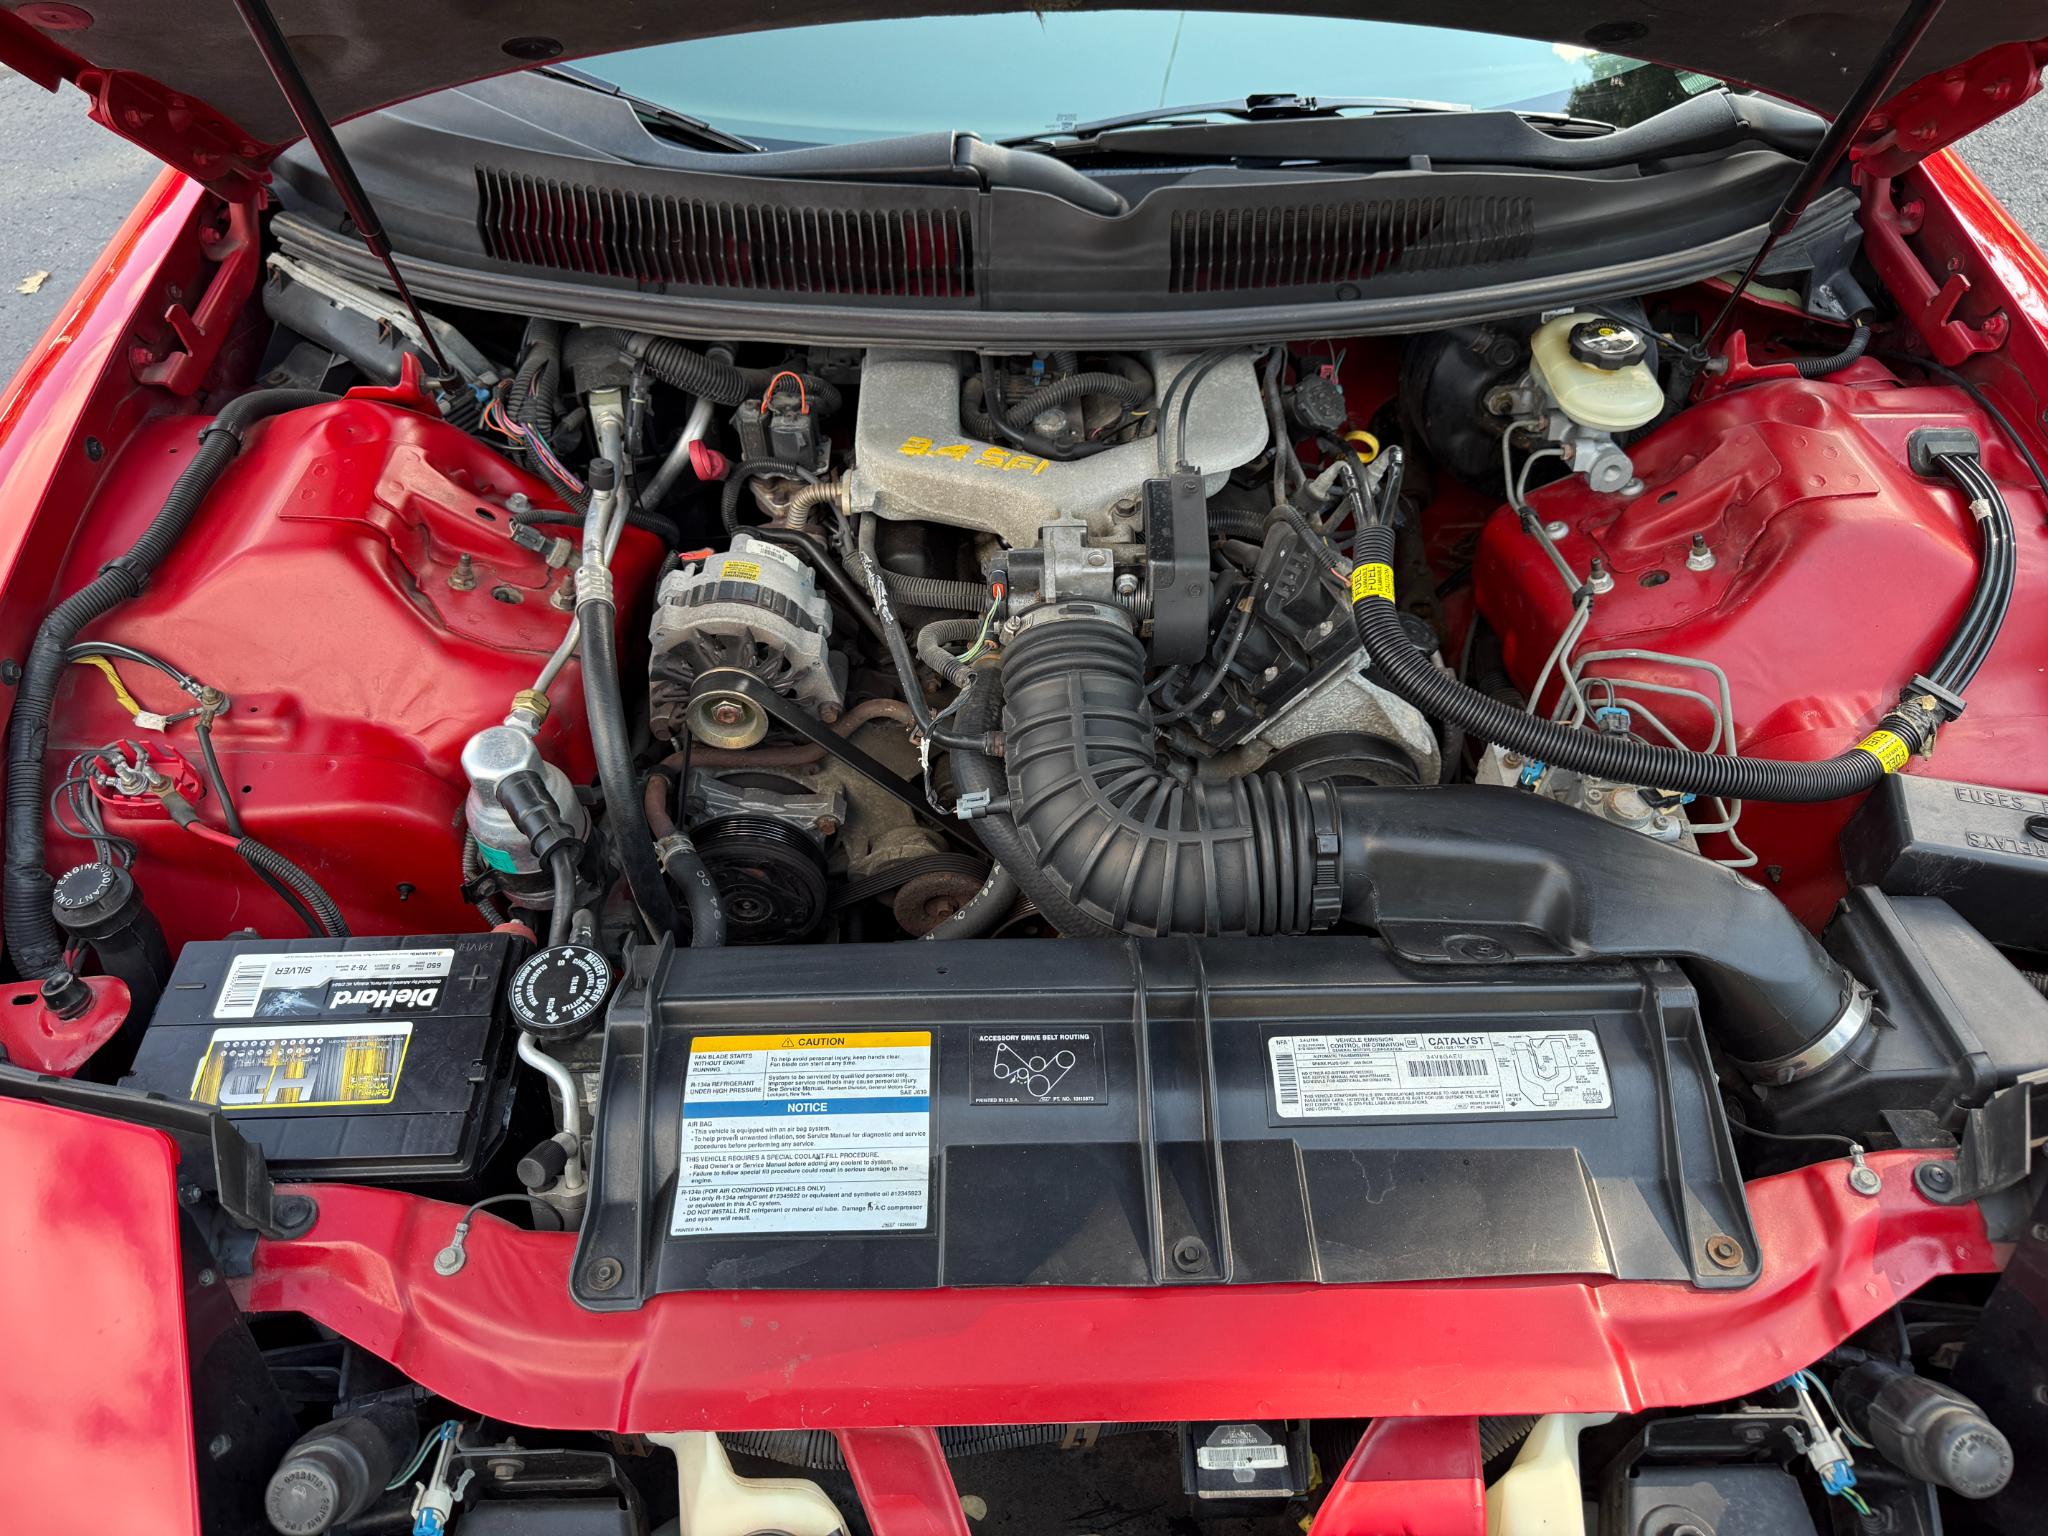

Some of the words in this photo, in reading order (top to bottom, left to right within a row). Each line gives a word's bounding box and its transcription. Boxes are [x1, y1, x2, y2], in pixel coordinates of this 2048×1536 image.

[974, 447, 1050, 475] SFI
[1368, 567, 1376, 590] FUEL
[1864, 734, 1888, 747] FUEL
[1886, 750, 1906, 767] FUEL
[1954, 788, 2025, 810] FUSES
[1966, 832, 2047, 855] RELAYS
[57, 862, 101, 885] ENGINE
[78, 867, 111, 905] COOLANT
[54, 889, 73, 906] ONLY
[275, 966, 312, 976] SILVER
[572, 958, 591, 972] CHECK
[584, 952, 606, 976] NEVER
[516, 966, 532, 986] ARROW
[528, 964, 548, 983] CLOSED
[586, 970, 595, 987] LEVEL
[329, 988, 438, 1009] DieHard
[527, 985, 539, 1007] SYSTEM
[590, 978, 606, 1002] OPEN
[515, 993, 524, 1007] VENT
[561, 996, 586, 1013] BOTTLE
[520, 1005, 535, 1019] TUBE
[573, 1002, 593, 1018] HOT
[798, 1037, 845, 1046] CAUTION
[1428, 1037, 1485, 1046] CATALYST
[218, 1063, 319, 1104] HD
[787, 1102, 828, 1113] NOTICE
